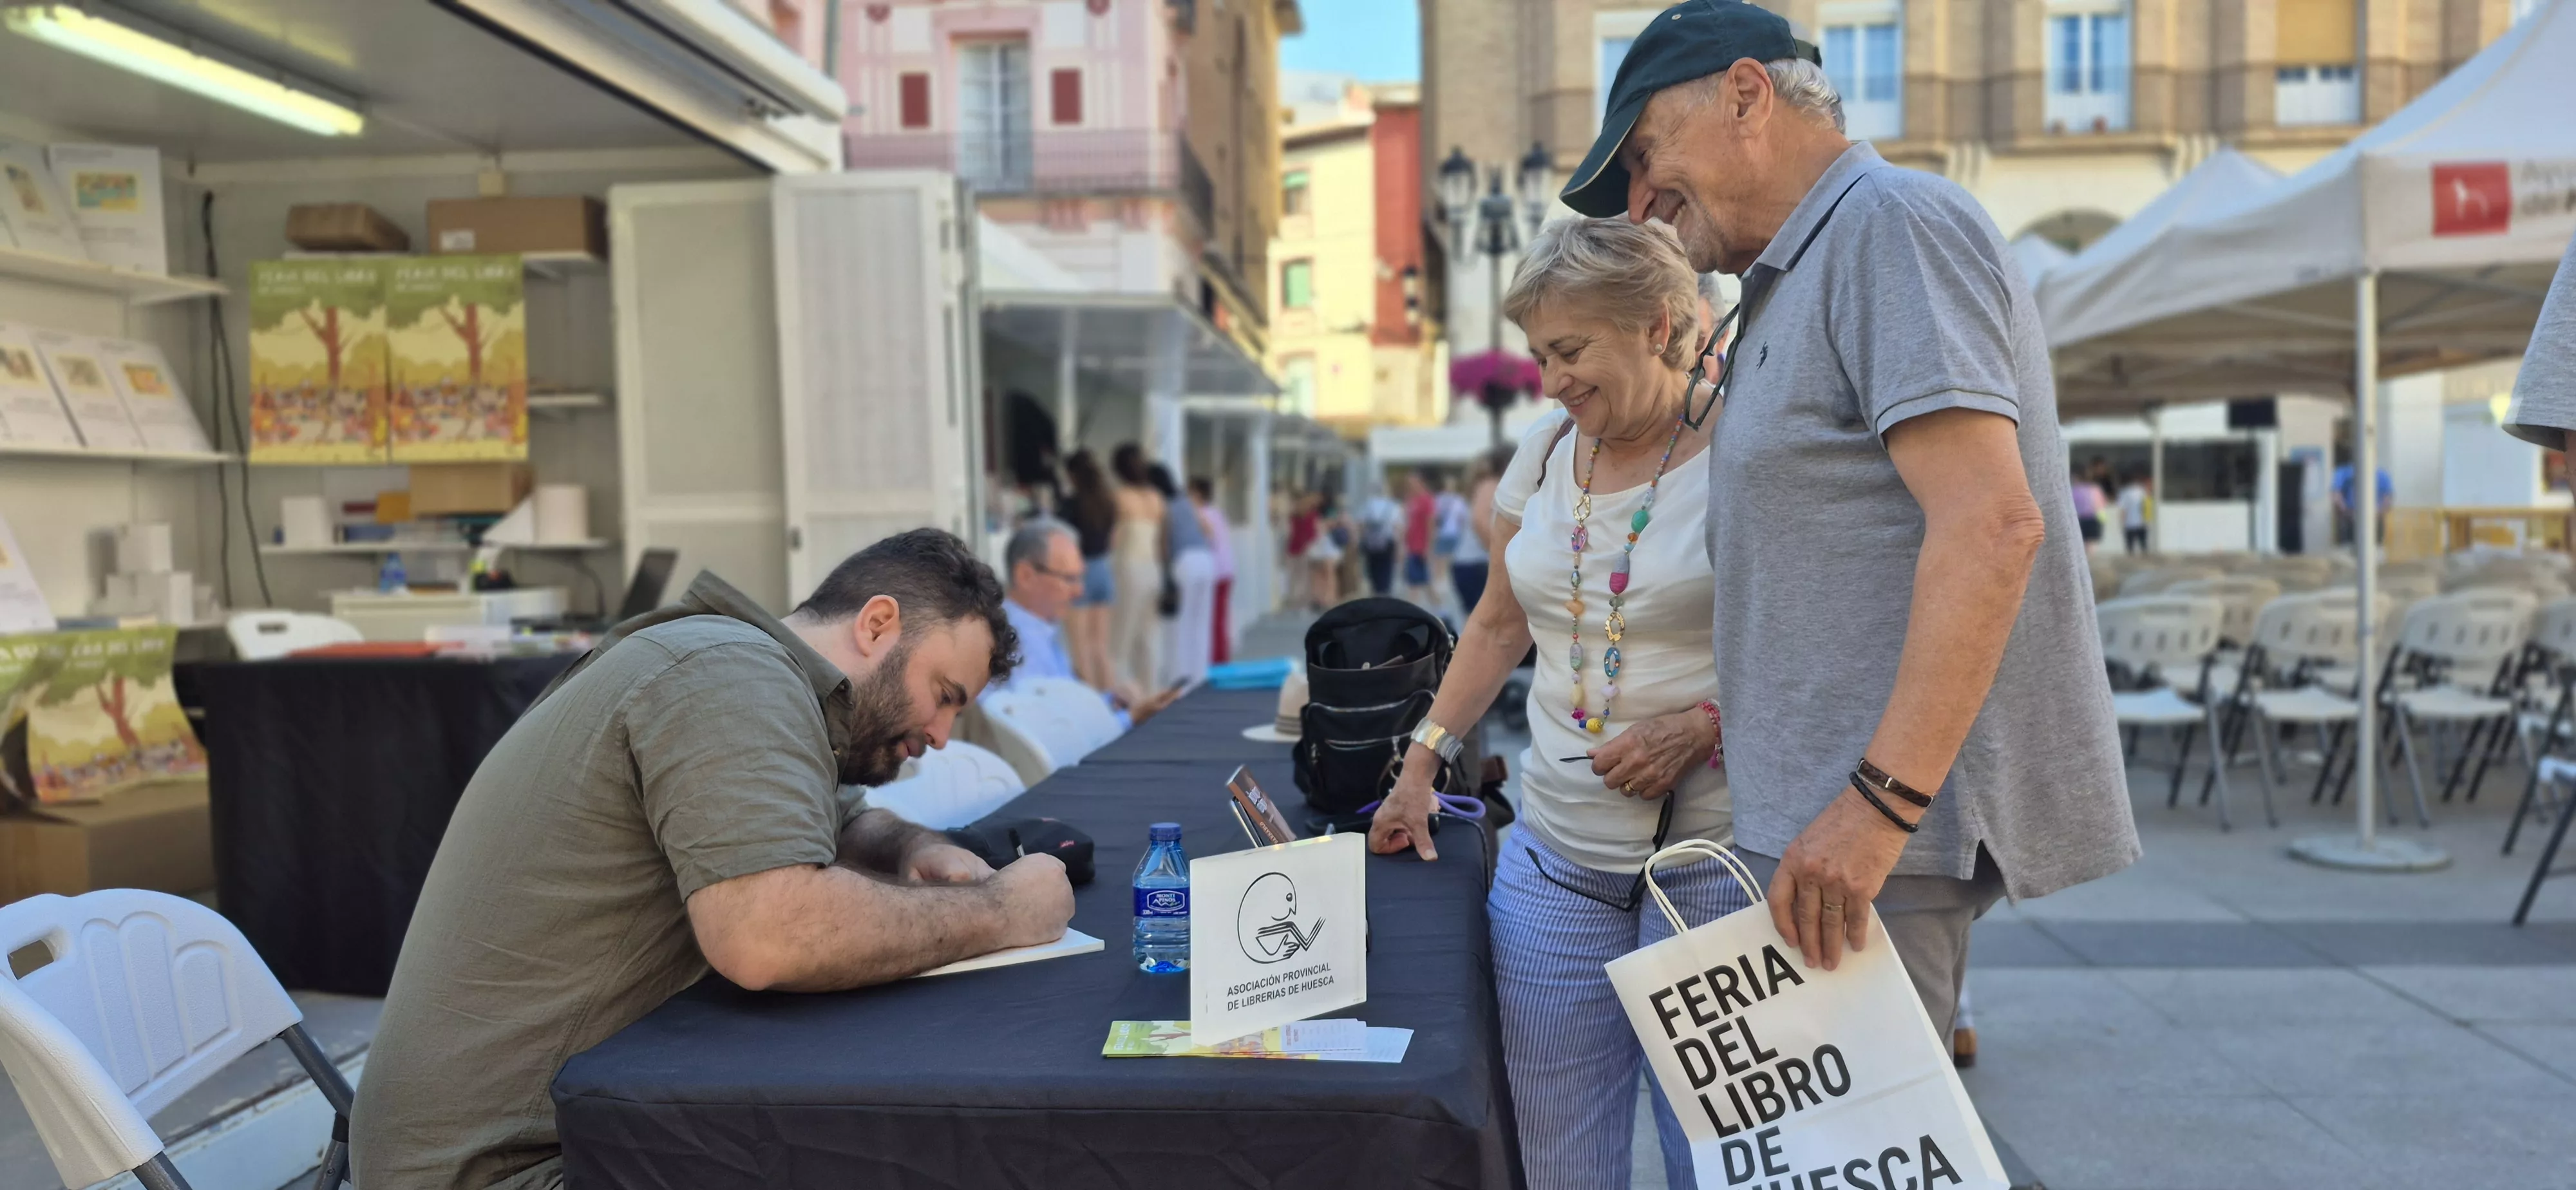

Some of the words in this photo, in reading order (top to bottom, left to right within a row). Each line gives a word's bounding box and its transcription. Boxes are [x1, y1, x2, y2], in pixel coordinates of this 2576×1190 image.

[1227, 974, 1280, 997] ASOCIACIÓN
[1283, 962, 1331, 982] PROVINCIAL
[1227, 999, 1239, 1011] DE
[1242, 987, 1286, 1007] LIBRERIAS
[1288, 984, 1299, 995] DE
[1302, 975, 1334, 992] HUESCA
[1649, 943, 1805, 1040] FERIA
[1672, 1015, 1779, 1090] DEL
[1698, 1043, 1852, 1138] LIBRO
[1720, 1126, 1790, 1186] DE
[1738, 1134, 1964, 1190] SCA
